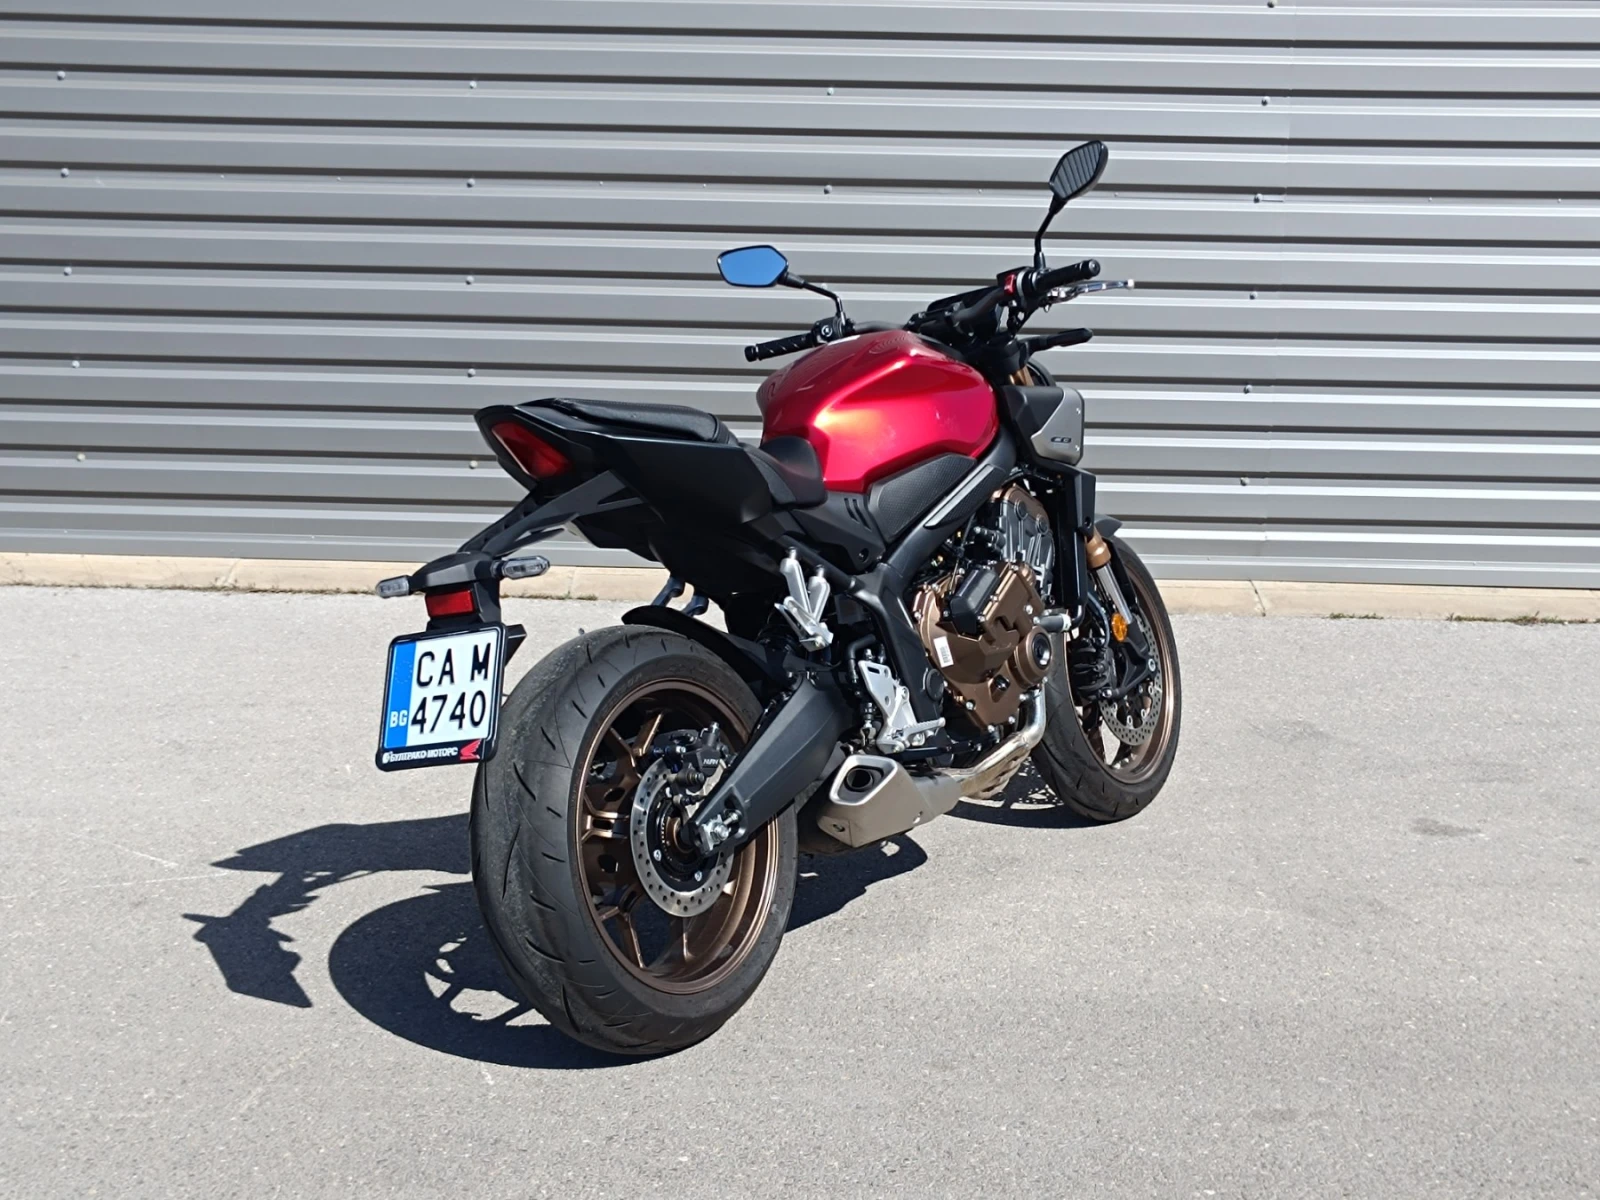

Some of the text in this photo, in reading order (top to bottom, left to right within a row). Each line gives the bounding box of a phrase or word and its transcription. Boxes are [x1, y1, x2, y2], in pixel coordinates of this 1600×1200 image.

[416, 642, 491, 688] CA M
[390, 710, 408, 728] BG
[411, 690, 486, 734] 4740
[427, 747, 458, 758] МОТОРС
